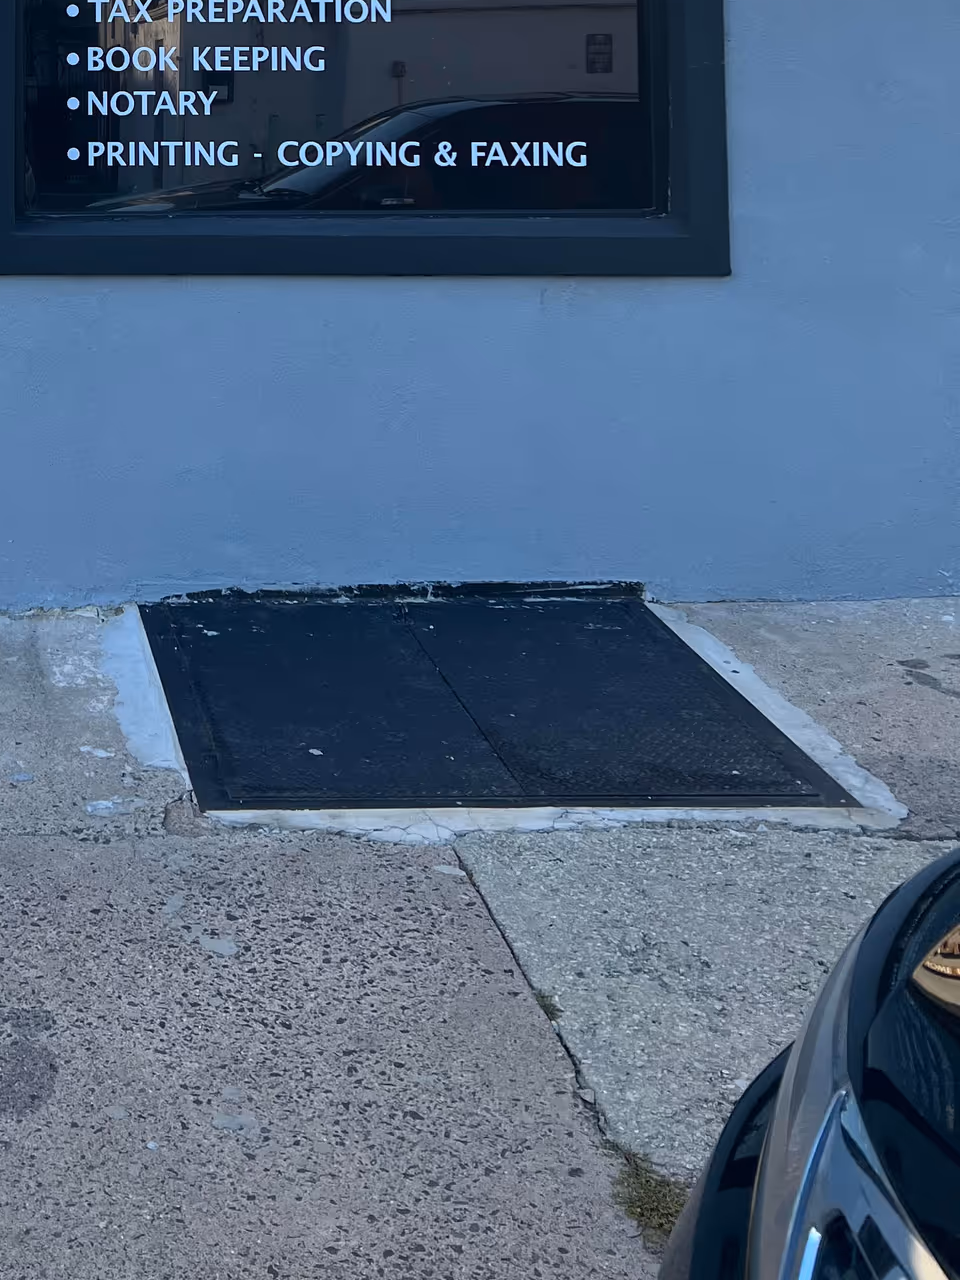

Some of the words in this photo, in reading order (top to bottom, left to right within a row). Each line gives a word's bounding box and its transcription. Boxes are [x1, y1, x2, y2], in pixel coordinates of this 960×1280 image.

[87, 46, 179, 73] BOOK
[193, 45, 326, 73] KEEPING
[87, 90, 219, 117] NOTARY
[88, 140, 240, 167] PRINTING
[277, 140, 422, 167] COPYING
[434, 140, 458, 168] &
[471, 140, 588, 167] FAXING
